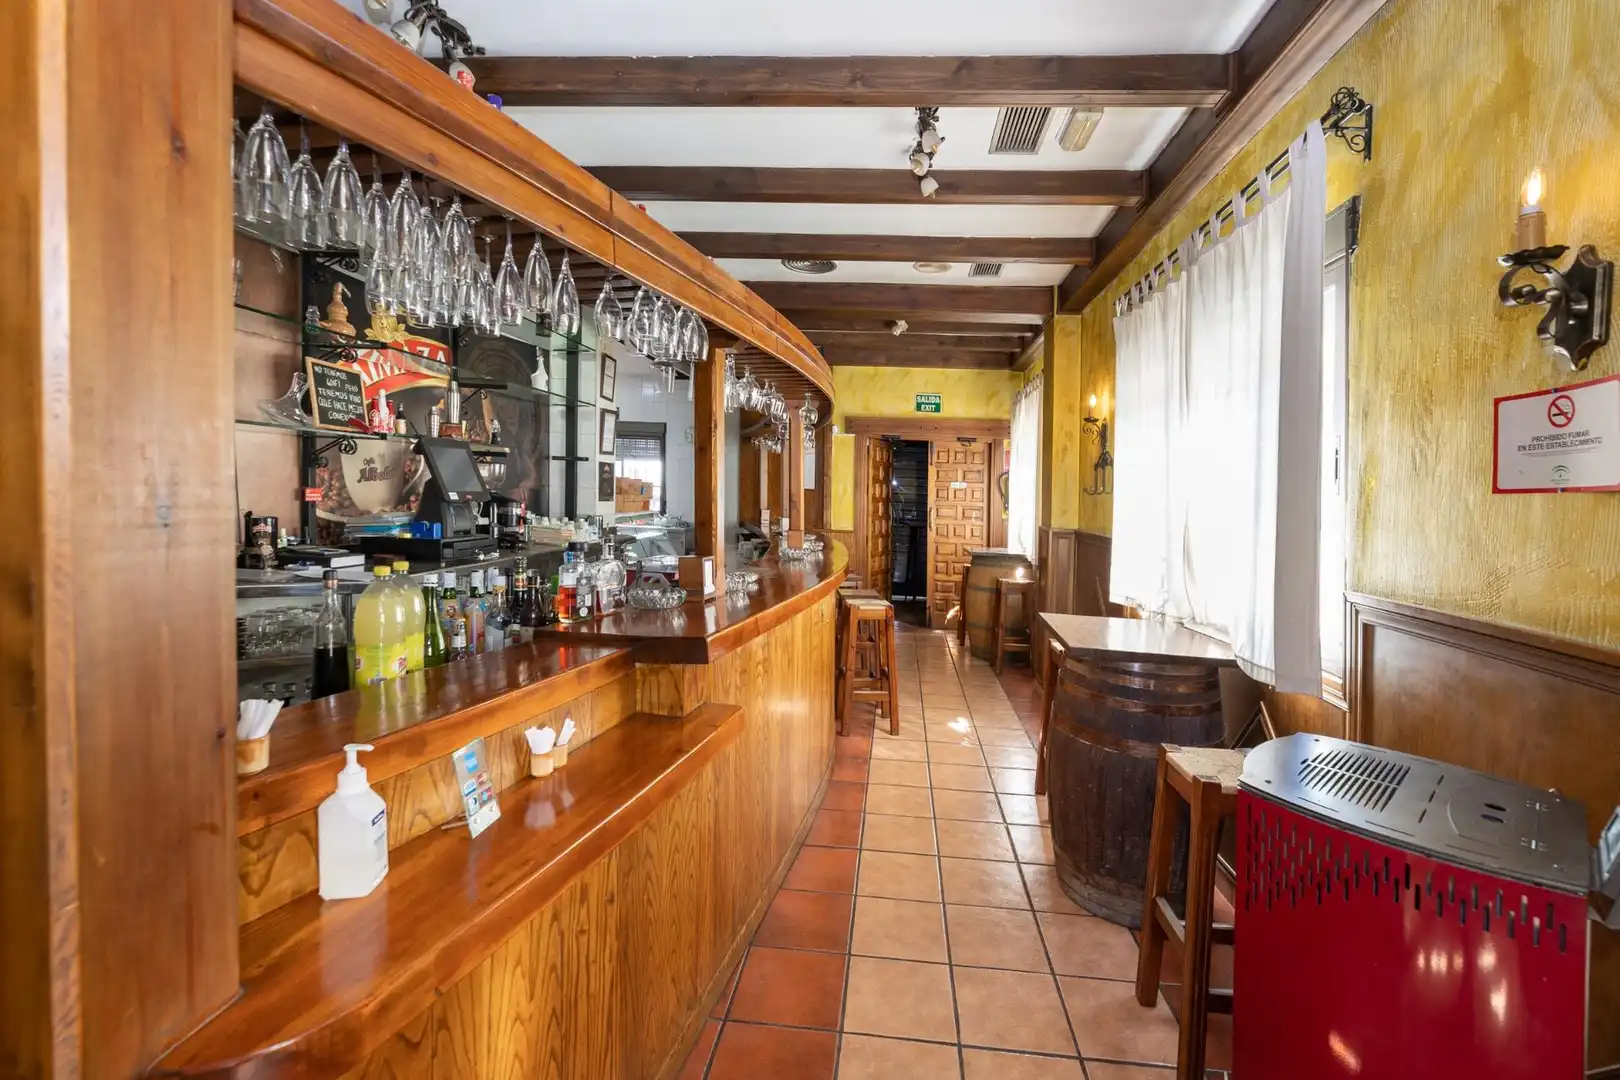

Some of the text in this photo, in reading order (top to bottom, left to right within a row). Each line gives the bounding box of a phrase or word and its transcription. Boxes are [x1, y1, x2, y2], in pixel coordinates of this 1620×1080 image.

[323, 367, 347, 379] TENEMOS
[327, 378, 358, 392] WIFI PERO
[318, 388, 361, 403] TENEMOS VINO
[318, 397, 332, 407] QUE
[333, 400, 347, 411] HACE
[328, 411, 356, 421] CONEX
[1531, 430, 1590, 443] PROHIBIDO FUMAR
[1518, 437, 1603, 452] EN ESTE ESTABLECIMIENTO
